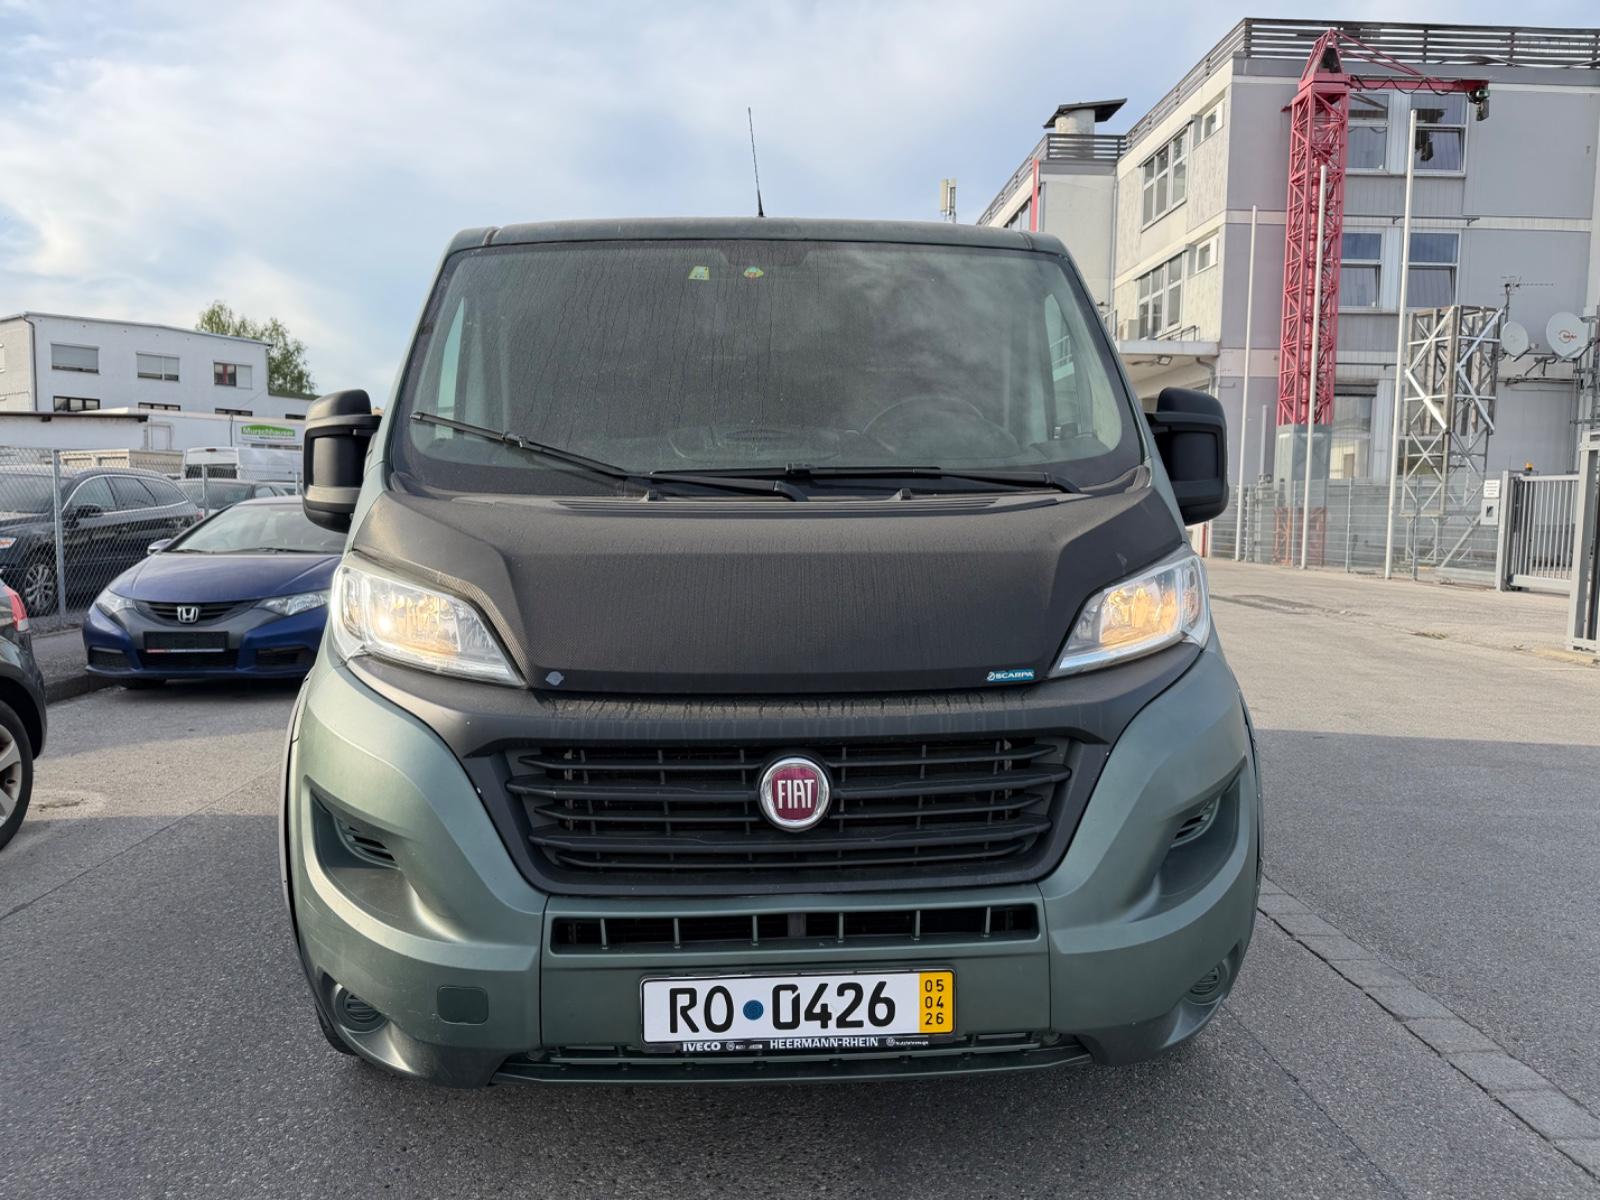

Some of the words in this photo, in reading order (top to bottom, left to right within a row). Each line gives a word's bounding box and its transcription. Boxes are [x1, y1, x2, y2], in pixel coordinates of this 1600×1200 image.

[995, 670, 1034, 679] SCARPA
[777, 779, 815, 810] FIAT
[925, 979, 944, 992] 05
[670, 986, 734, 1034] RO
[772, 981, 896, 1030] 0426
[925, 996, 944, 1009] 04
[925, 1012, 944, 1025] 26
[682, 1041, 721, 1052] IVECO
[770, 1037, 879, 1050] HEERMANN-RHEIN
